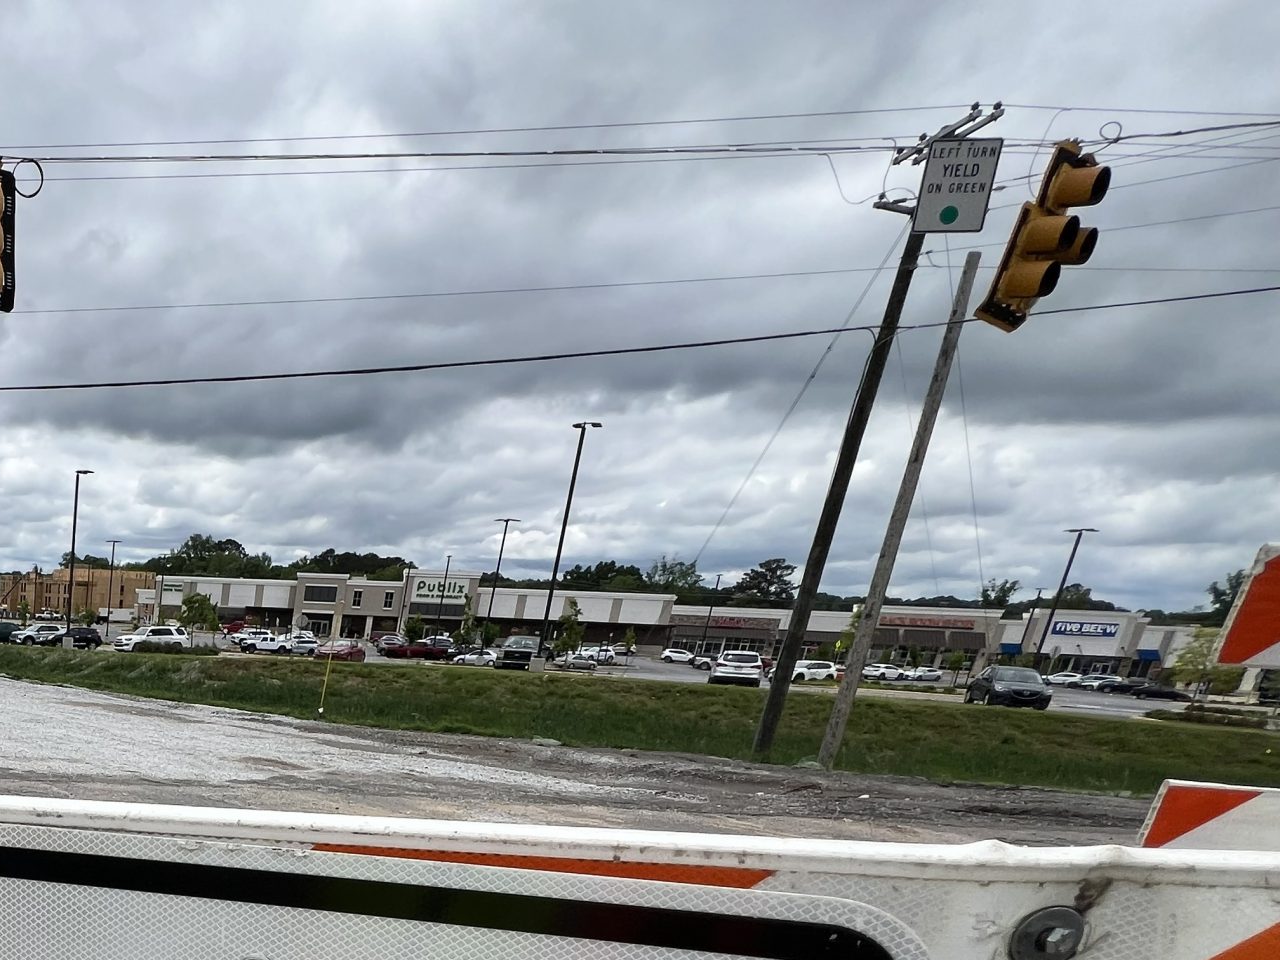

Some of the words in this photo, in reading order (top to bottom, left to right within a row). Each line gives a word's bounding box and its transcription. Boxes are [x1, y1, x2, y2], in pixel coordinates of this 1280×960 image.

[932, 147, 961, 159] LEFT
[967, 146, 997, 158] TURN
[943, 163, 980, 178] YIELD
[927, 183, 943, 194] ON
[949, 182, 987, 194] GREEN
[417, 580, 464, 593] Publix
[1055, 622, 1081, 632] five
